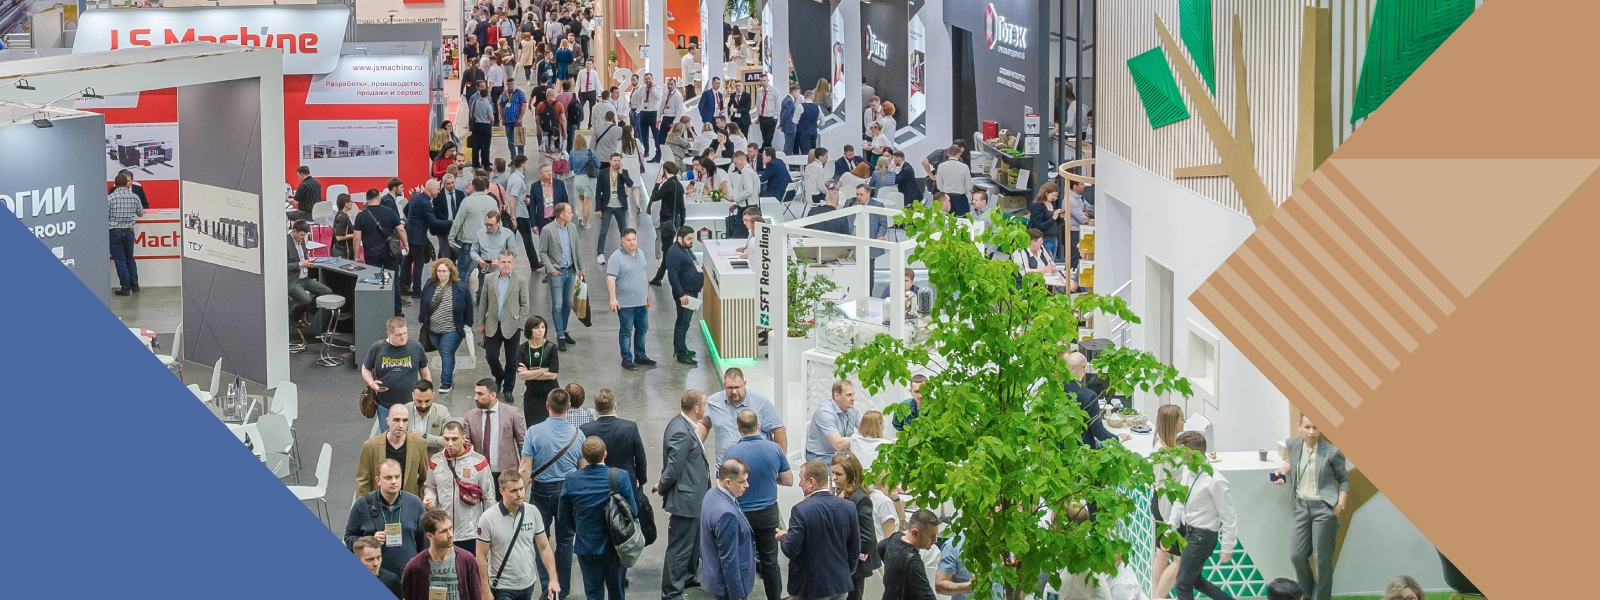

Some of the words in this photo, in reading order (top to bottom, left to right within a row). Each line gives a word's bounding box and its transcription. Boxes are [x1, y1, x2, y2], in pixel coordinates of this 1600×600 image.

[352, 64, 423, 72] www.jsmachine.ru
[325, 80, 370, 88] Разработки,
[759, 226, 771, 286] Recycling
[760, 287, 770, 312] SFT
